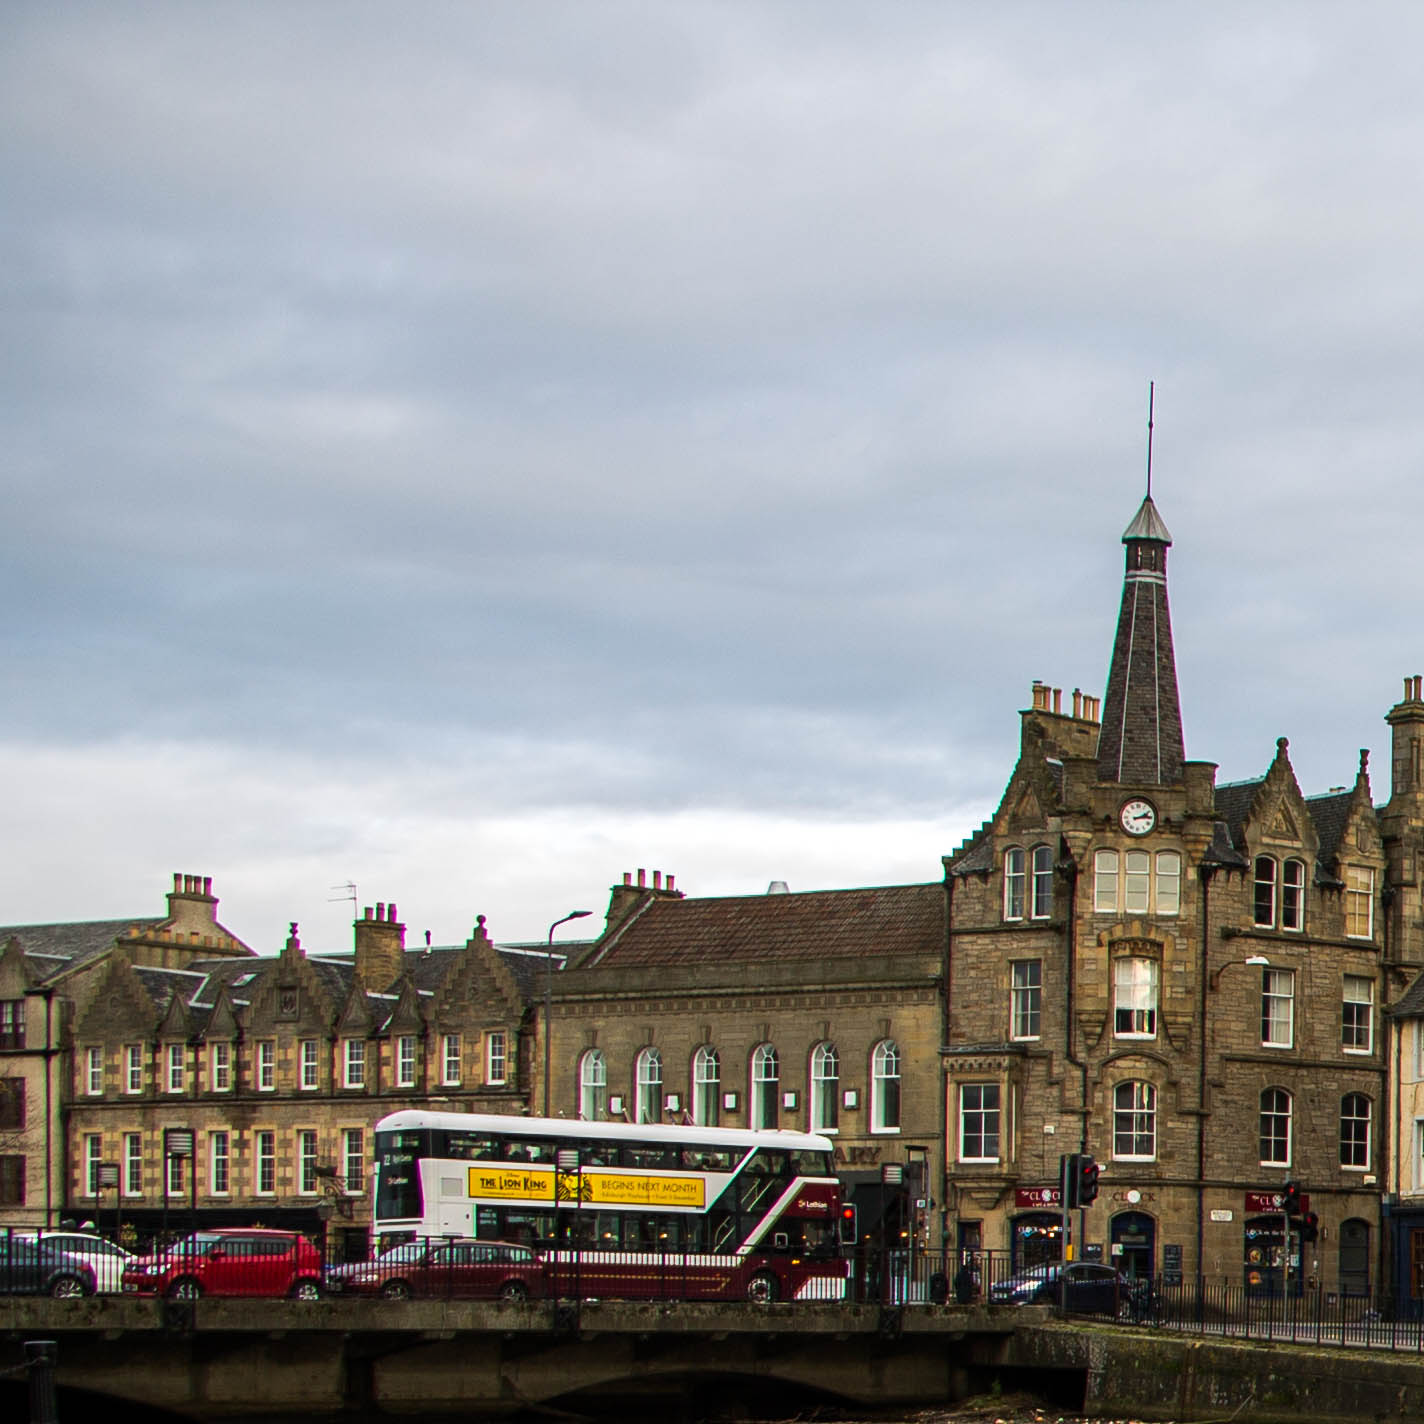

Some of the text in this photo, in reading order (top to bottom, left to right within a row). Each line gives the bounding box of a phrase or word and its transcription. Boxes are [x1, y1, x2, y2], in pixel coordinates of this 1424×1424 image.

[480, 1175, 547, 1191] THE LION KING
[601, 1180, 697, 1193] BEGINS NEXT MONTH
